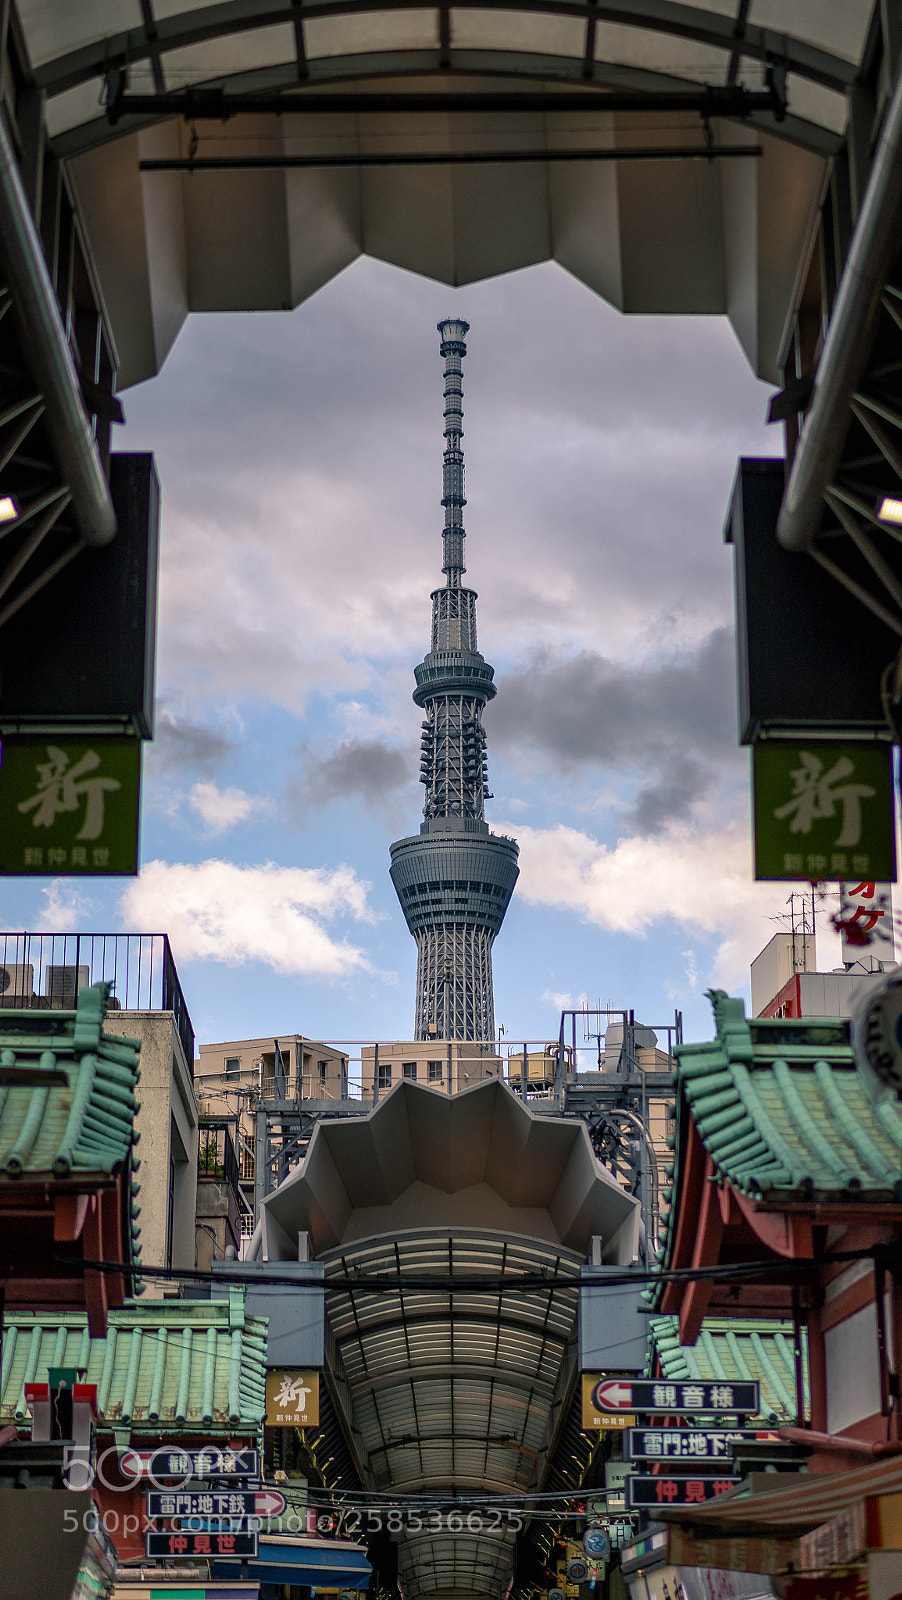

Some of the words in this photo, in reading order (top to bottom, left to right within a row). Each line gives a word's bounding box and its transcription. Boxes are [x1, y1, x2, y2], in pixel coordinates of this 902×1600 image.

[273, 1374, 312, 1412] 新
[652, 1384, 734, 1408] 観音様
[593, 1417, 626, 1426] 新仲見世
[168, 1534, 236, 1554] 仲見世
